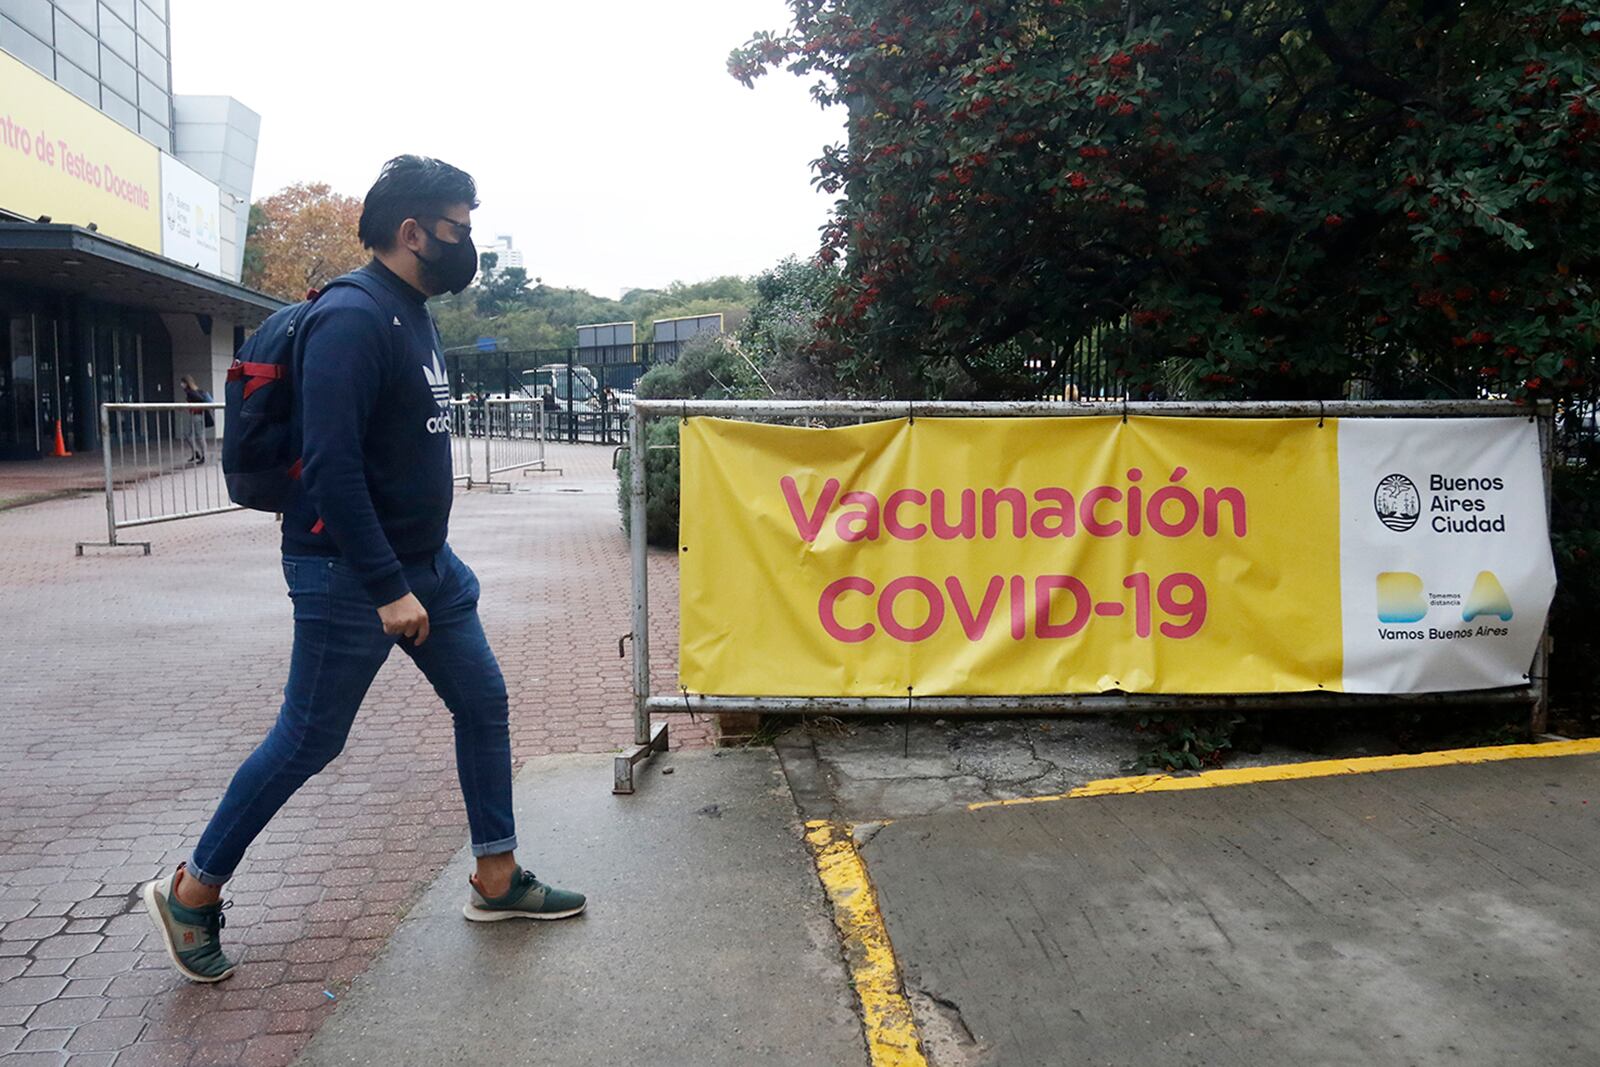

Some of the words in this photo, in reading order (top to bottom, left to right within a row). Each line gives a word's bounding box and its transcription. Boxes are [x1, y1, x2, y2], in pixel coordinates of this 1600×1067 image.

[35, 130, 55, 167] de
[57, 139, 102, 189] Testeo
[103, 163, 150, 211] Docente
[1430, 474, 1505, 491] Buenos
[780, 467, 1247, 542] Vacunación
[1430, 495, 1486, 512] Aires
[1431, 514, 1506, 533] Ciudad
[1428, 592, 1462, 600] Tomemos
[818, 572, 1207, 643] COVID-19
[1378, 628, 1425, 640] Vamos
[1428, 628, 1474, 640] Buenos
[1475, 625, 1509, 637] Aires
